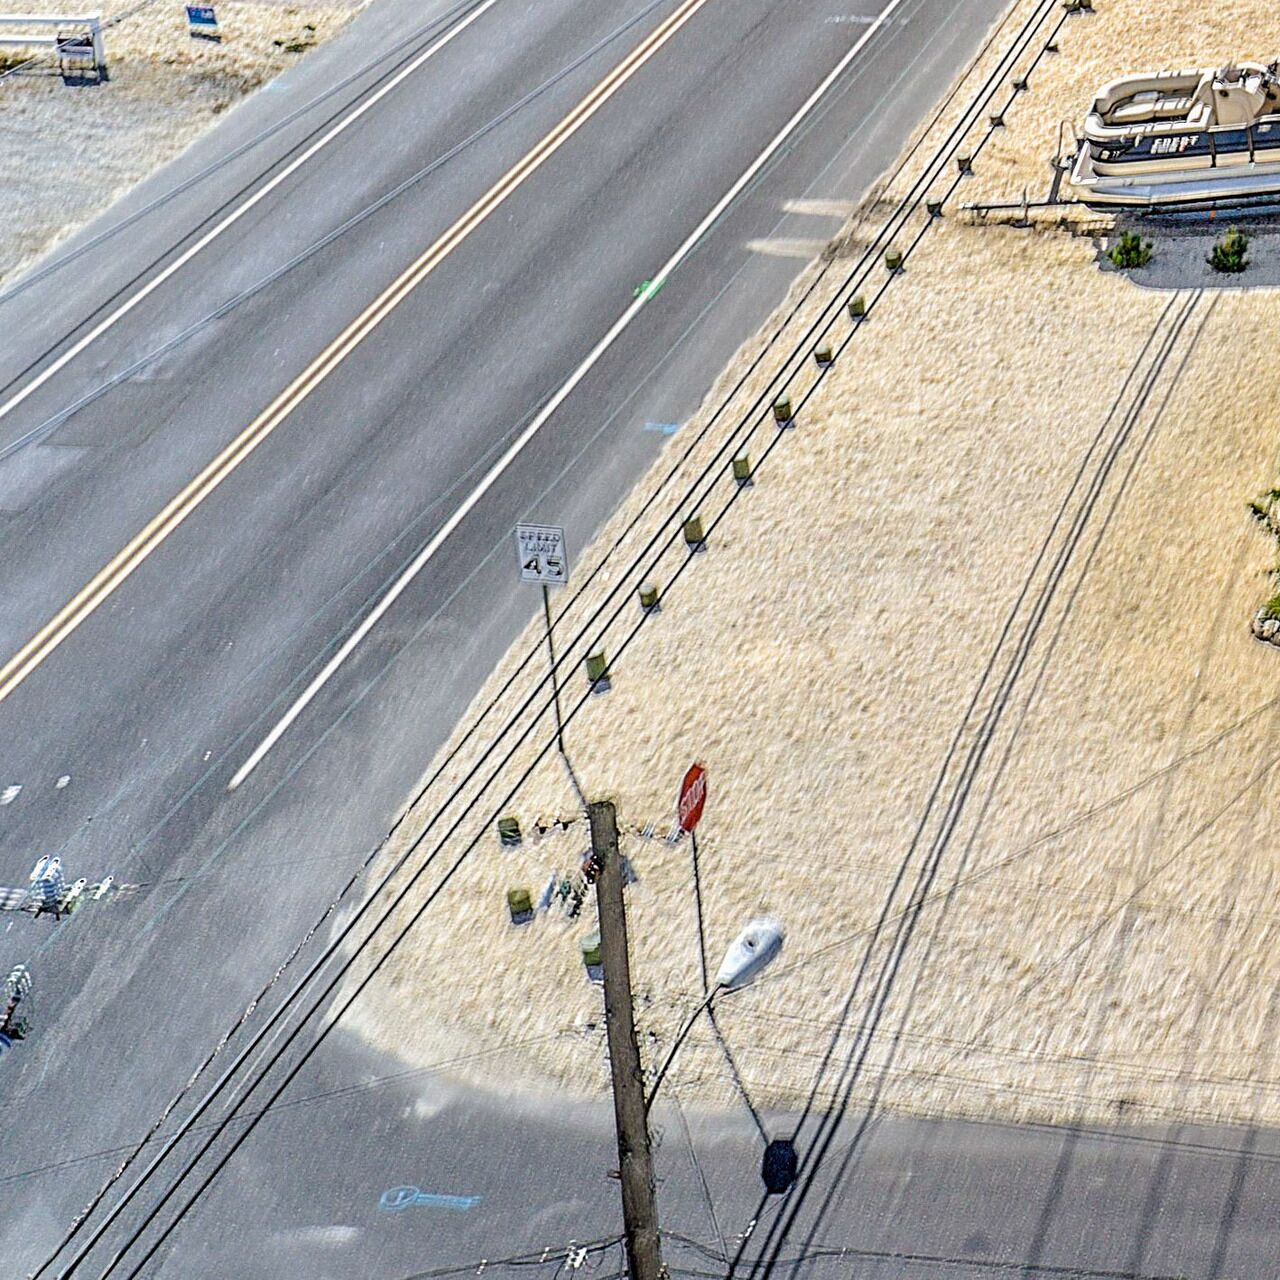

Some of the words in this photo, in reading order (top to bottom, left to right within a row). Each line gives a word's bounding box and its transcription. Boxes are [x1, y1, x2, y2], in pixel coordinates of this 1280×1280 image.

[520, 531, 560, 543] SPEED
[525, 542, 558, 554] LIMIT
[523, 554, 564, 578] 45
[680, 770, 705, 825] STOP
